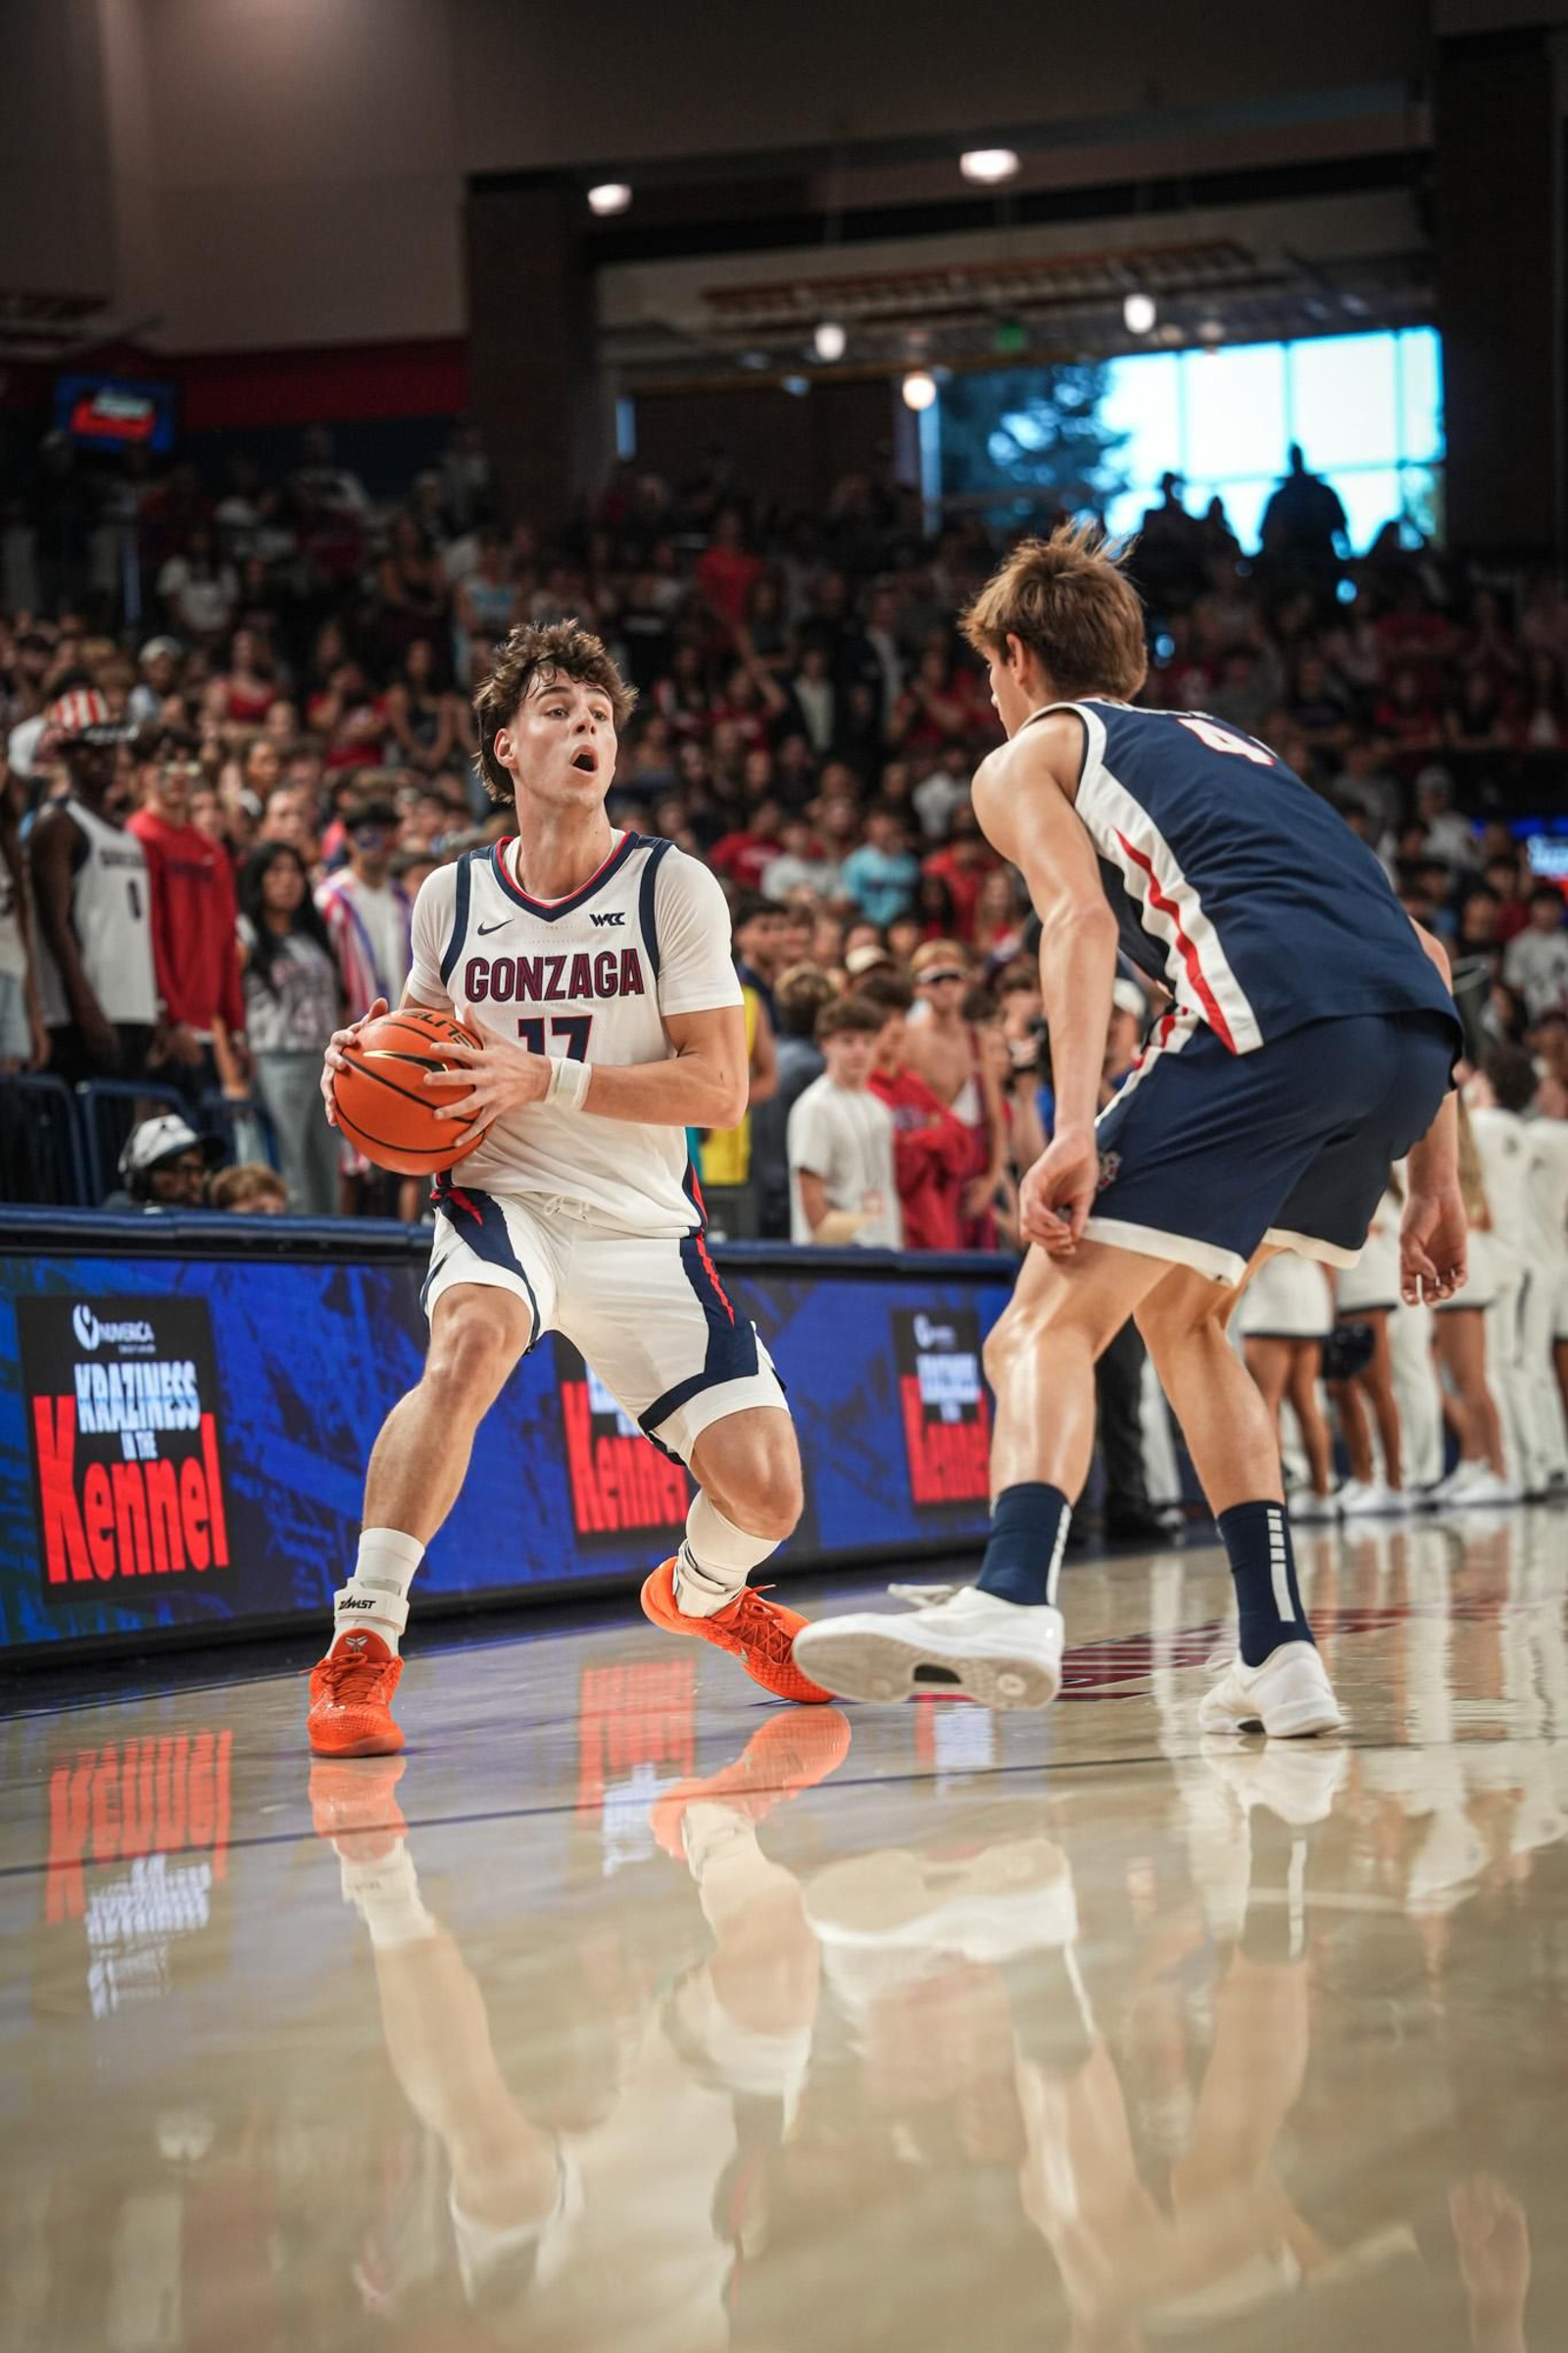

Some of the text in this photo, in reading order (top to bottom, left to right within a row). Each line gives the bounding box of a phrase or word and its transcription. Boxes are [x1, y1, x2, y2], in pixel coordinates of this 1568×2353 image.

[465, 948, 645, 1004] GONZAGA
[74, 1360, 201, 1435] KRAZINESS
[32, 1396, 230, 1585] Kennel
